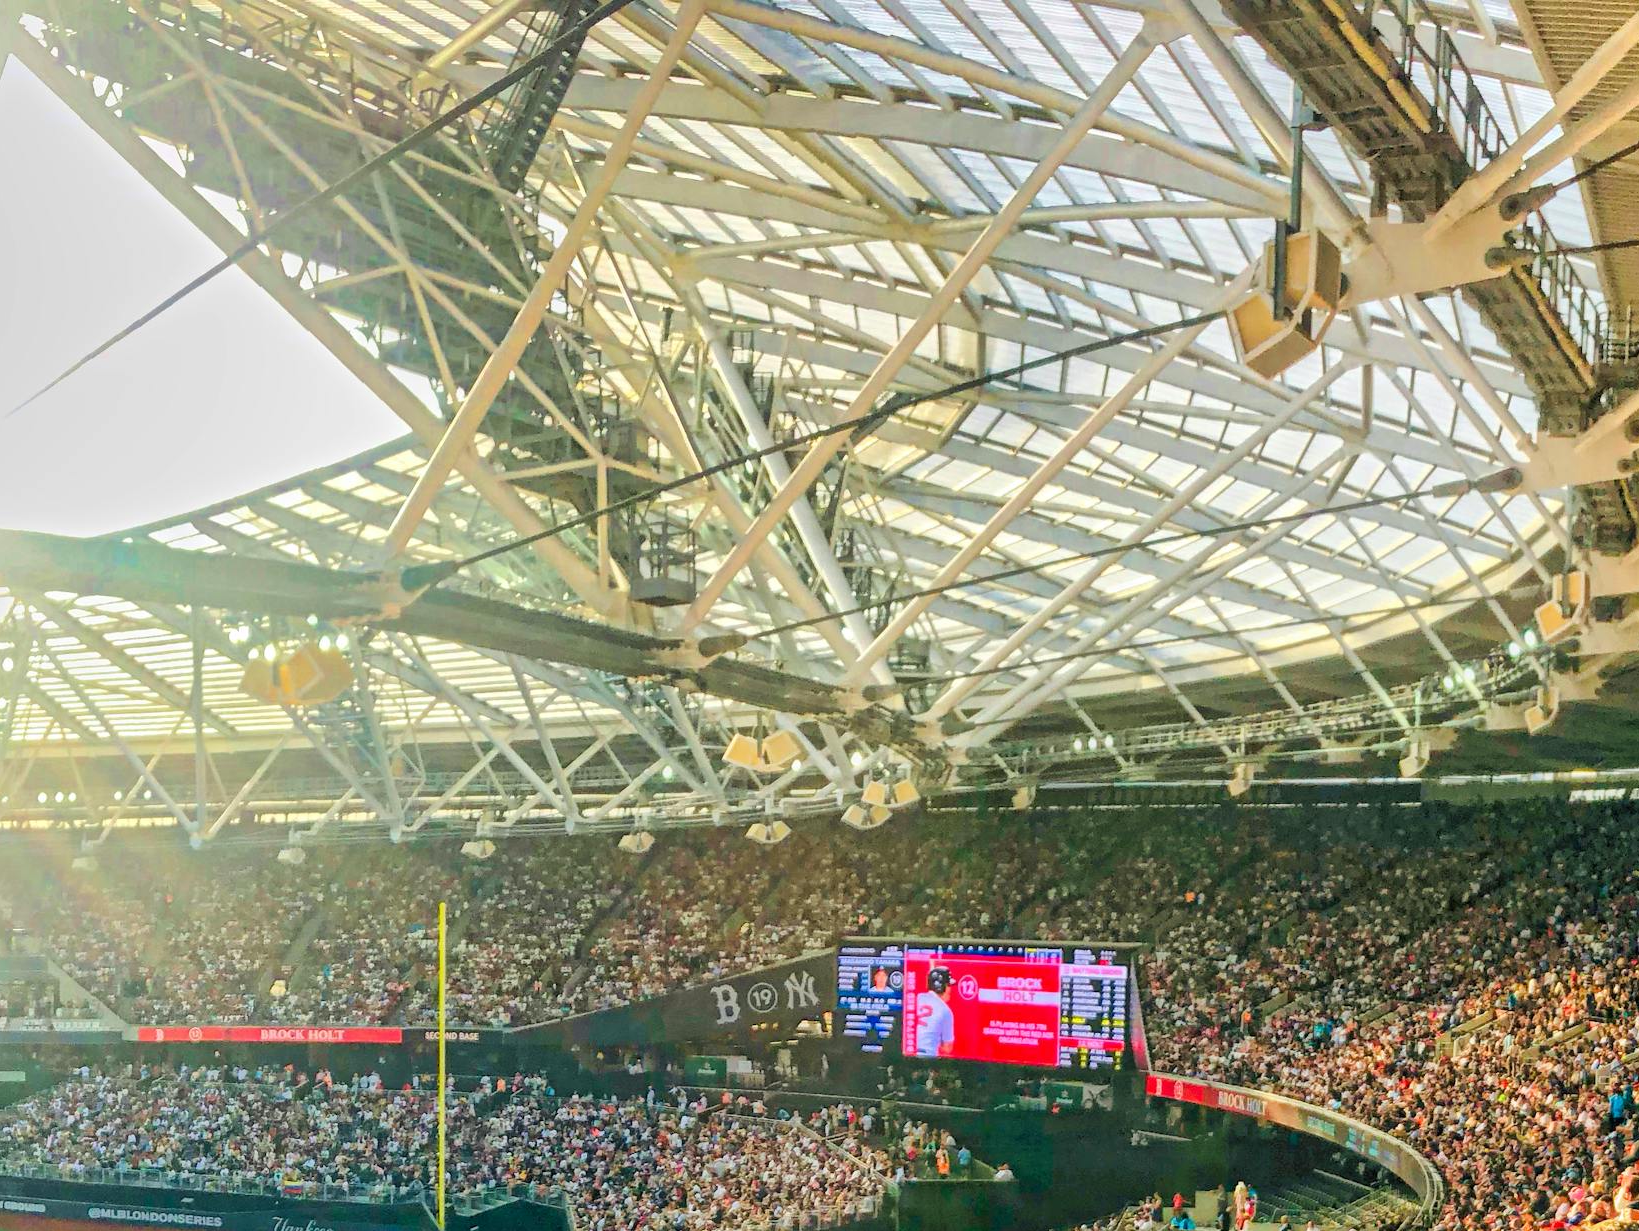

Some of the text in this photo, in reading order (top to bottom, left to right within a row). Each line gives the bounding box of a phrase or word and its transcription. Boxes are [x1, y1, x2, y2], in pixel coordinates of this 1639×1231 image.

[961, 980, 975, 994] 12
[997, 977, 1042, 989] BROCK
[710, 984, 741, 1025] B
[752, 989, 772, 1007] 19
[784, 970, 820, 1010] NY
[1004, 992, 1036, 1001] HOLT
[260, 1029, 305, 1041] BROCK
[308, 1029, 345, 1041] HOLT
[425, 1032, 479, 1041] SECND BASE
[1218, 1090, 1245, 1110] BROCK
[1247, 1096, 1268, 1115] HOLT
[88, 1206, 223, 1228] @MLBLONDONSERIES
